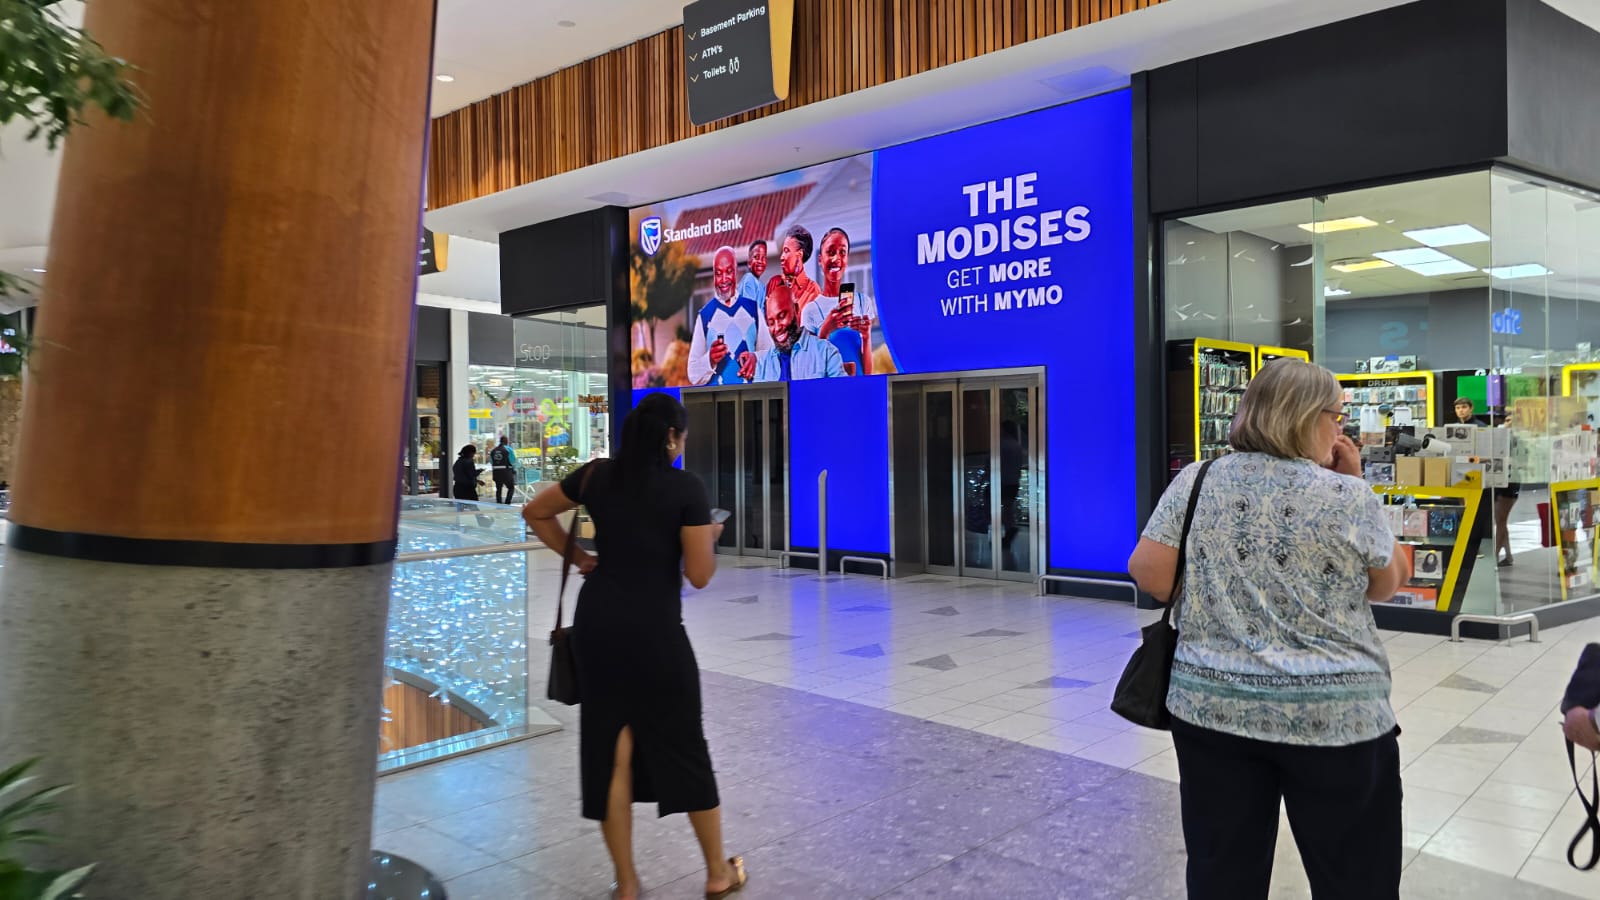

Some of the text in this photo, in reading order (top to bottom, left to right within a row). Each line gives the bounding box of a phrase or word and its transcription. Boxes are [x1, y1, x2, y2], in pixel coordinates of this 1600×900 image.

[701, 5, 766, 37] Basement Parking
[702, 44, 723, 59] ATM's
[703, 65, 727, 79] Toilets
[962, 172, 1038, 217] THE
[663, 213, 743, 243] Standard Bank
[917, 205, 1091, 265] MODISES
[947, 256, 1051, 289] GET MORE
[940, 284, 1063, 317] WITH MYMO
[1368, 379, 1400, 387] DRONE
